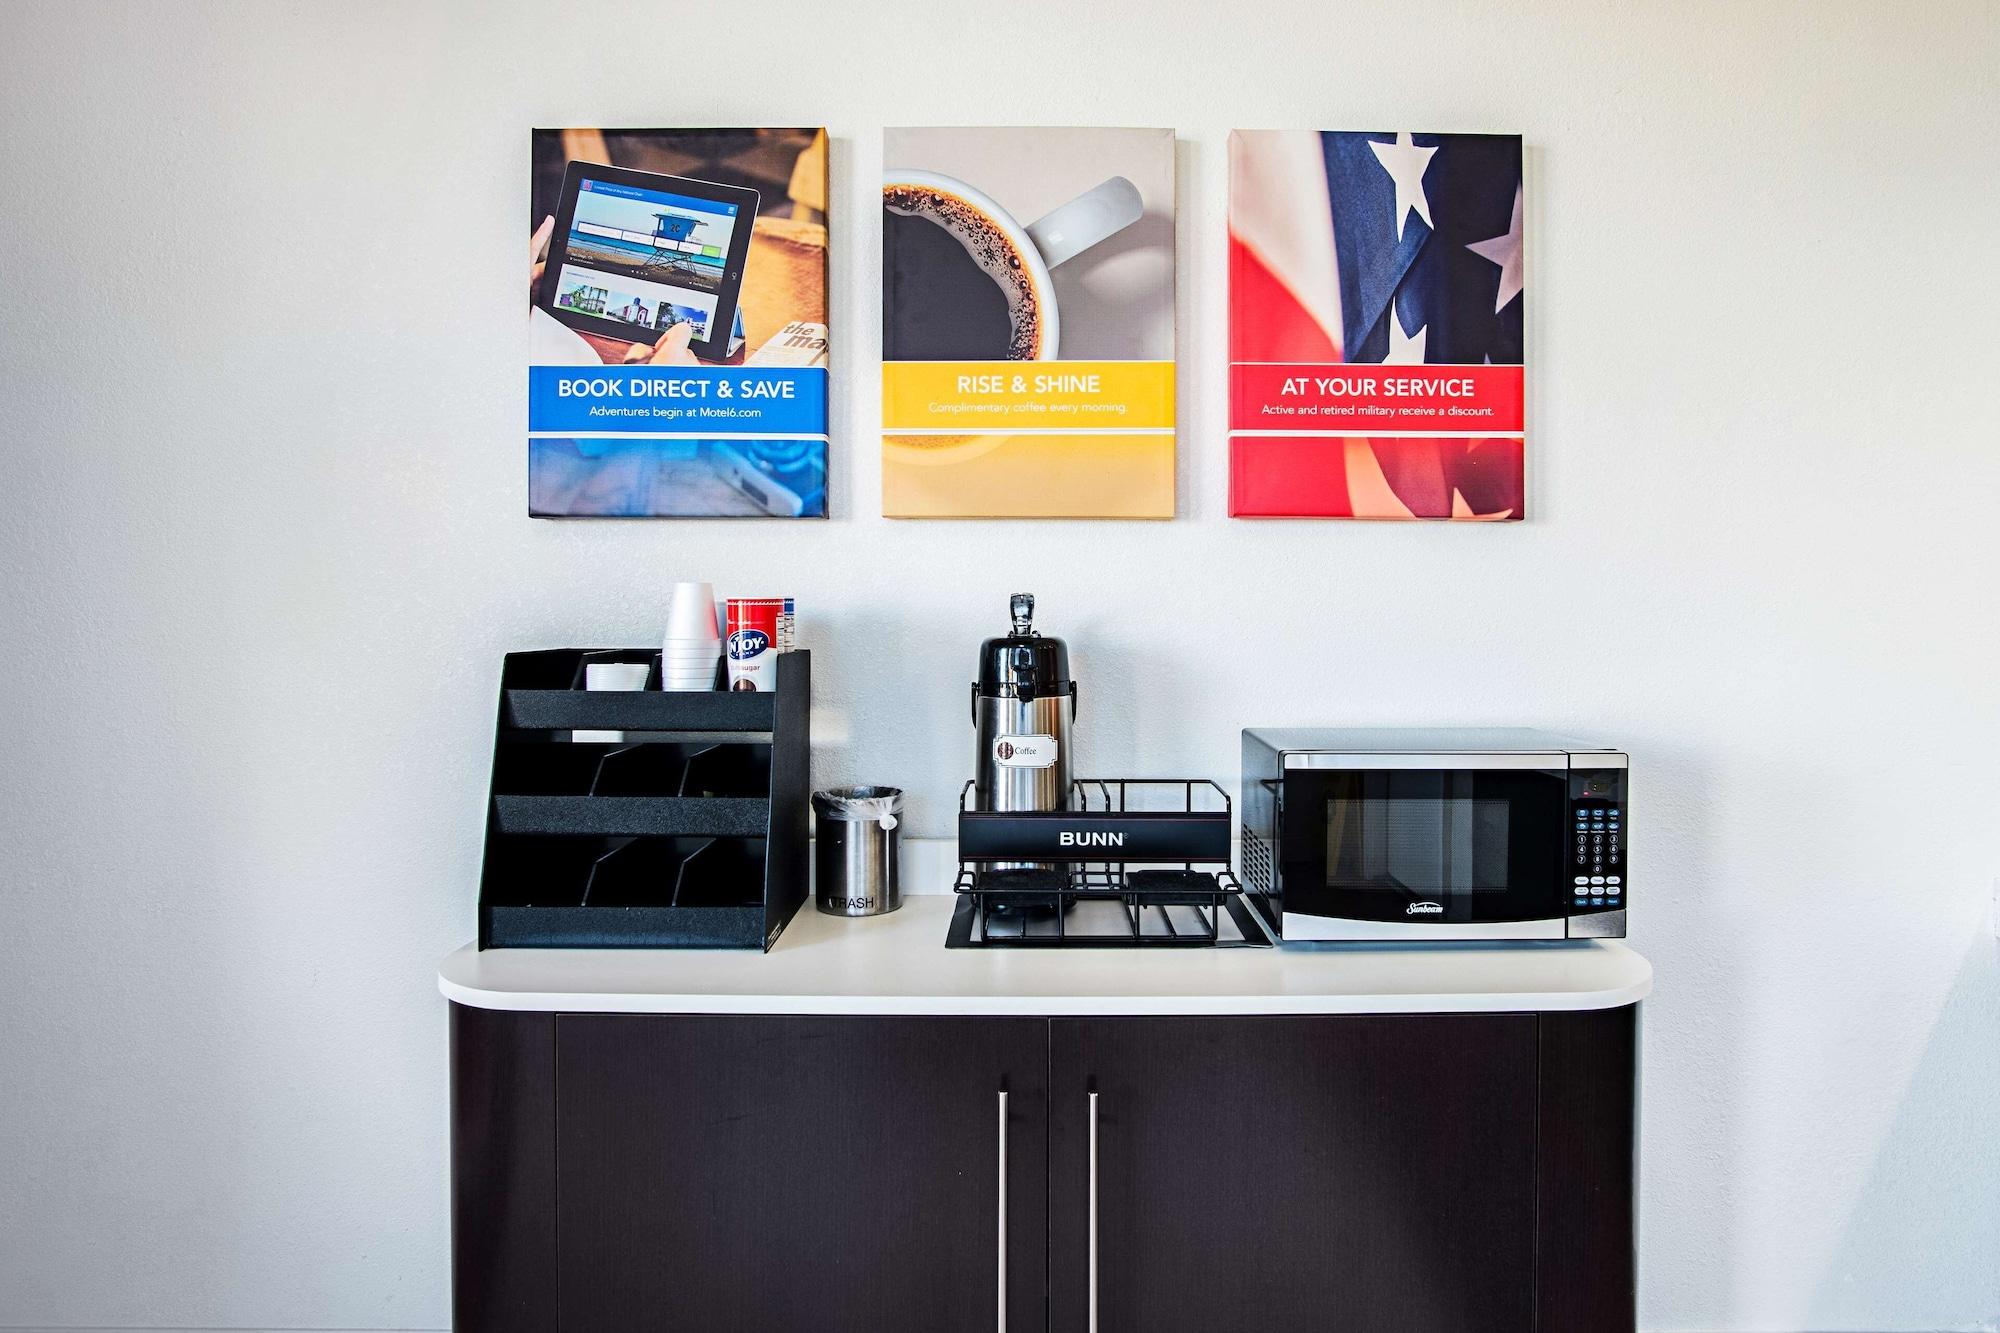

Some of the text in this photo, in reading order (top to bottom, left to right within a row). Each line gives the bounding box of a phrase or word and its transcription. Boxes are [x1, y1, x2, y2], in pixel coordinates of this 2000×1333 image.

[784, 322, 815, 335] the
[558, 379, 795, 399] BOOK DIRECT & SAVE
[957, 375, 1100, 393] RISE & SHINE
[1281, 378, 1474, 397] AT YOUR SERVICE
[589, 406, 762, 419] Adventures begin at Motel6.com
[928, 402, 1010, 415] Complimentary
[1013, 401, 1047, 413] coffee
[1050, 404, 1079, 415] every
[1262, 404, 1495, 418] Active and retired military receive a discount.
[1014, 746, 1037, 755] Coffee
[1059, 831, 1123, 846] BUNN
[1406, 902, 1443, 914] Sunbeam
